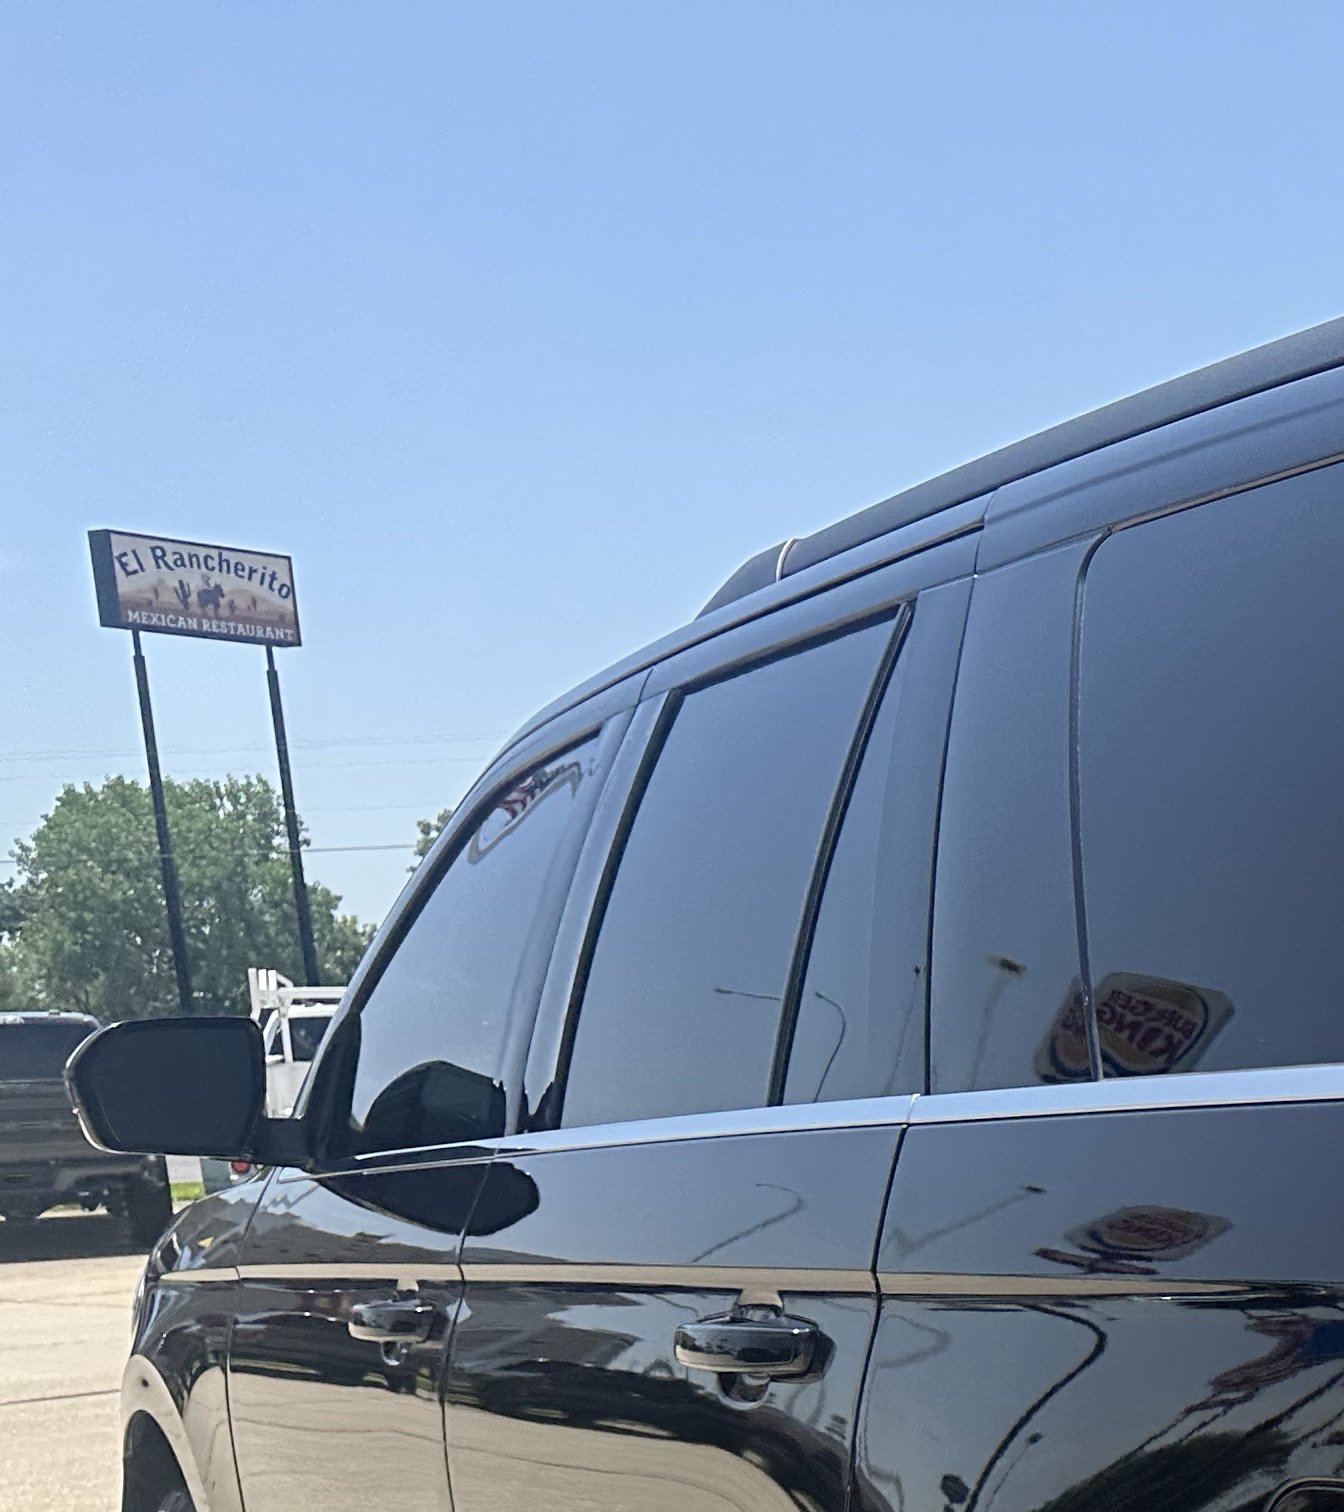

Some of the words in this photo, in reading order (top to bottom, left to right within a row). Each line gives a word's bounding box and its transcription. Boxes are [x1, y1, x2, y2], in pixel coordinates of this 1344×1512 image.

[115, 549, 146, 578] El
[150, 545, 292, 600] Rancherito
[128, 609, 198, 631] MEXICAN
[202, 619, 297, 641] RESTAURANT
